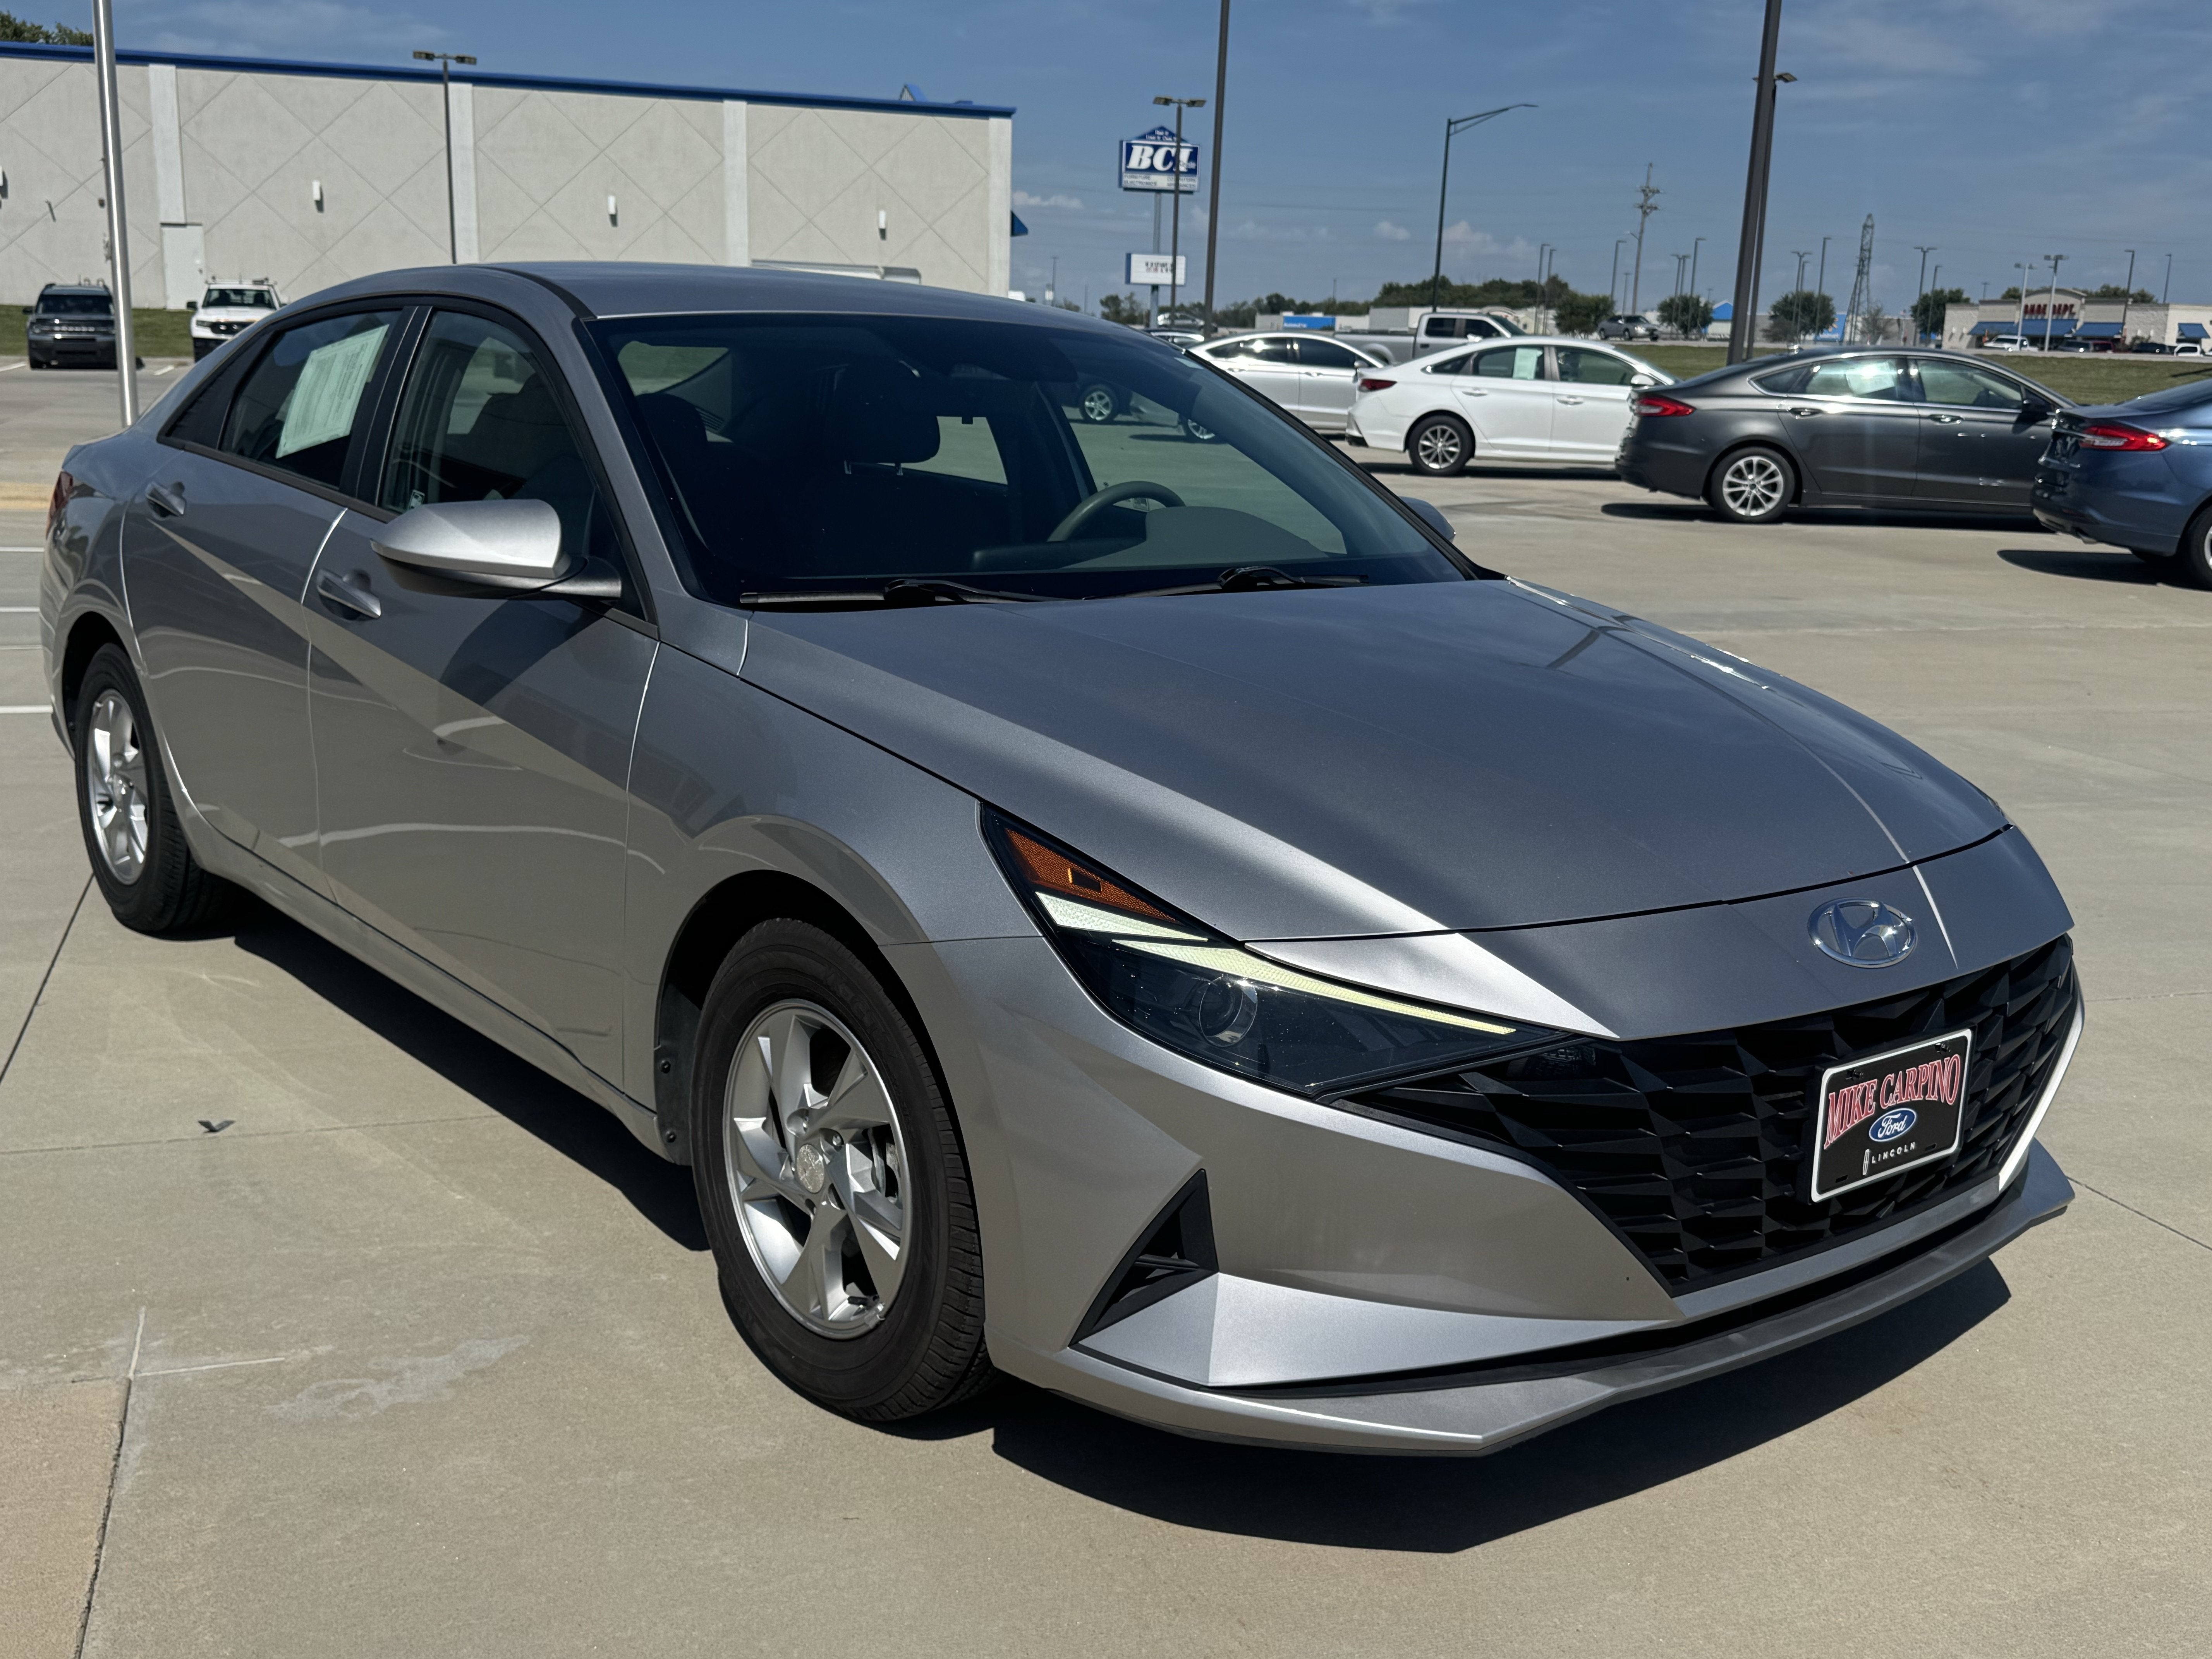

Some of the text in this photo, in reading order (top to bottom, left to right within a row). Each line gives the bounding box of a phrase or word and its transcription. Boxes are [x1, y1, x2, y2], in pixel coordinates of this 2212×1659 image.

[1127, 146, 1193, 172] BCI
[1824, 1054, 1960, 1149] MIKE CARPINO
[1878, 1113, 1907, 1138] Ford
[1872, 1142, 1915, 1164] LINCOLN
